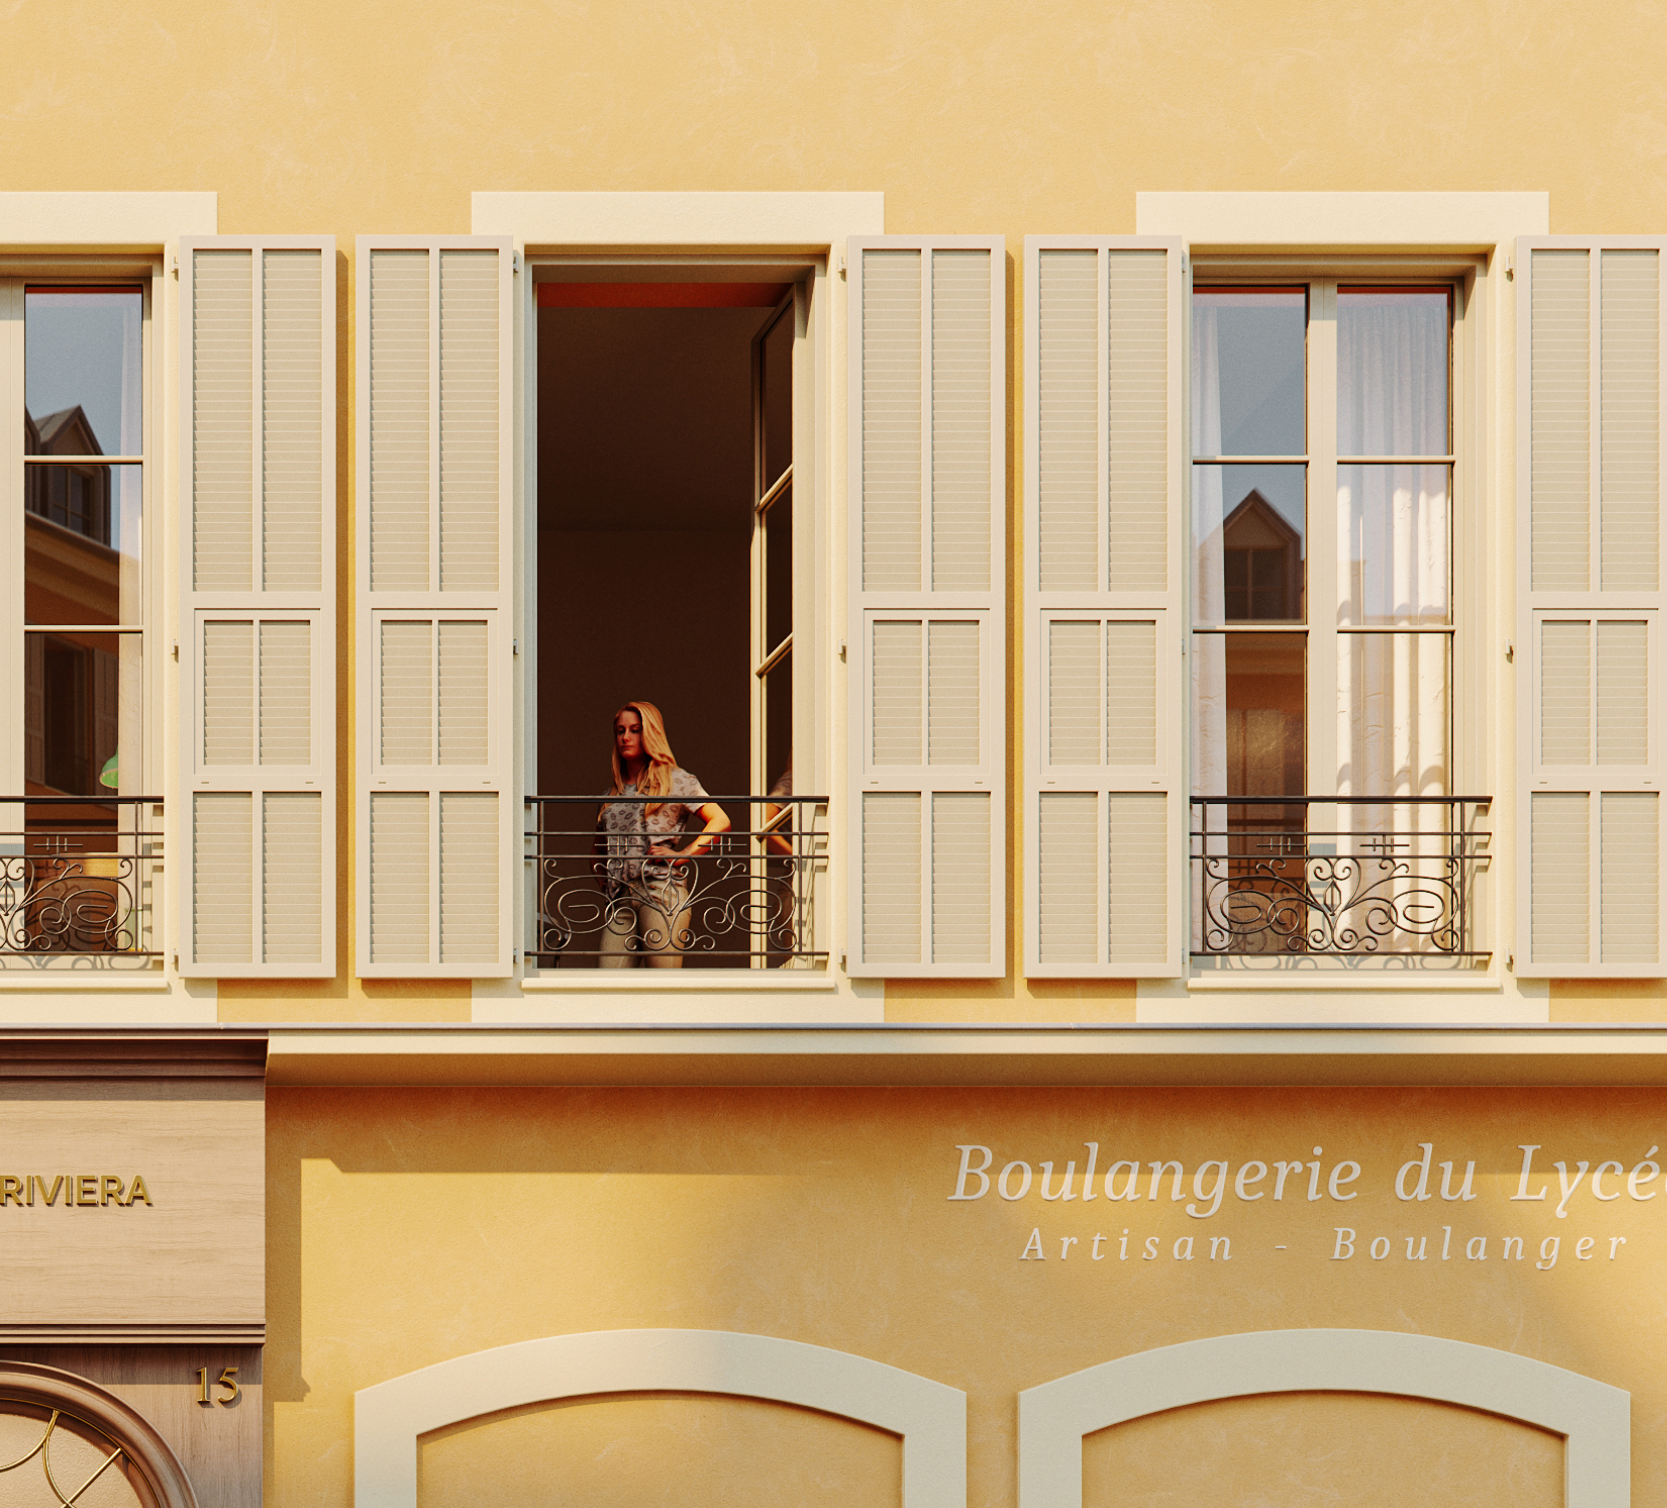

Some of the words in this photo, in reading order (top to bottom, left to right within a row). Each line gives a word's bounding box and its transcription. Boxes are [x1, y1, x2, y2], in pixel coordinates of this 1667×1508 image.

[0, 1175, 153, 1206] RIVIERA
[947, 1142, 1361, 1219] Boulangerie
[1395, 1143, 1477, 1202] du
[1510, 1145, 1667, 1219] Lycé
[1019, 1228, 1233, 1261] Artisan
[1330, 1226, 1628, 1270] Boulanger
[196, 1367, 240, 1405] 15
